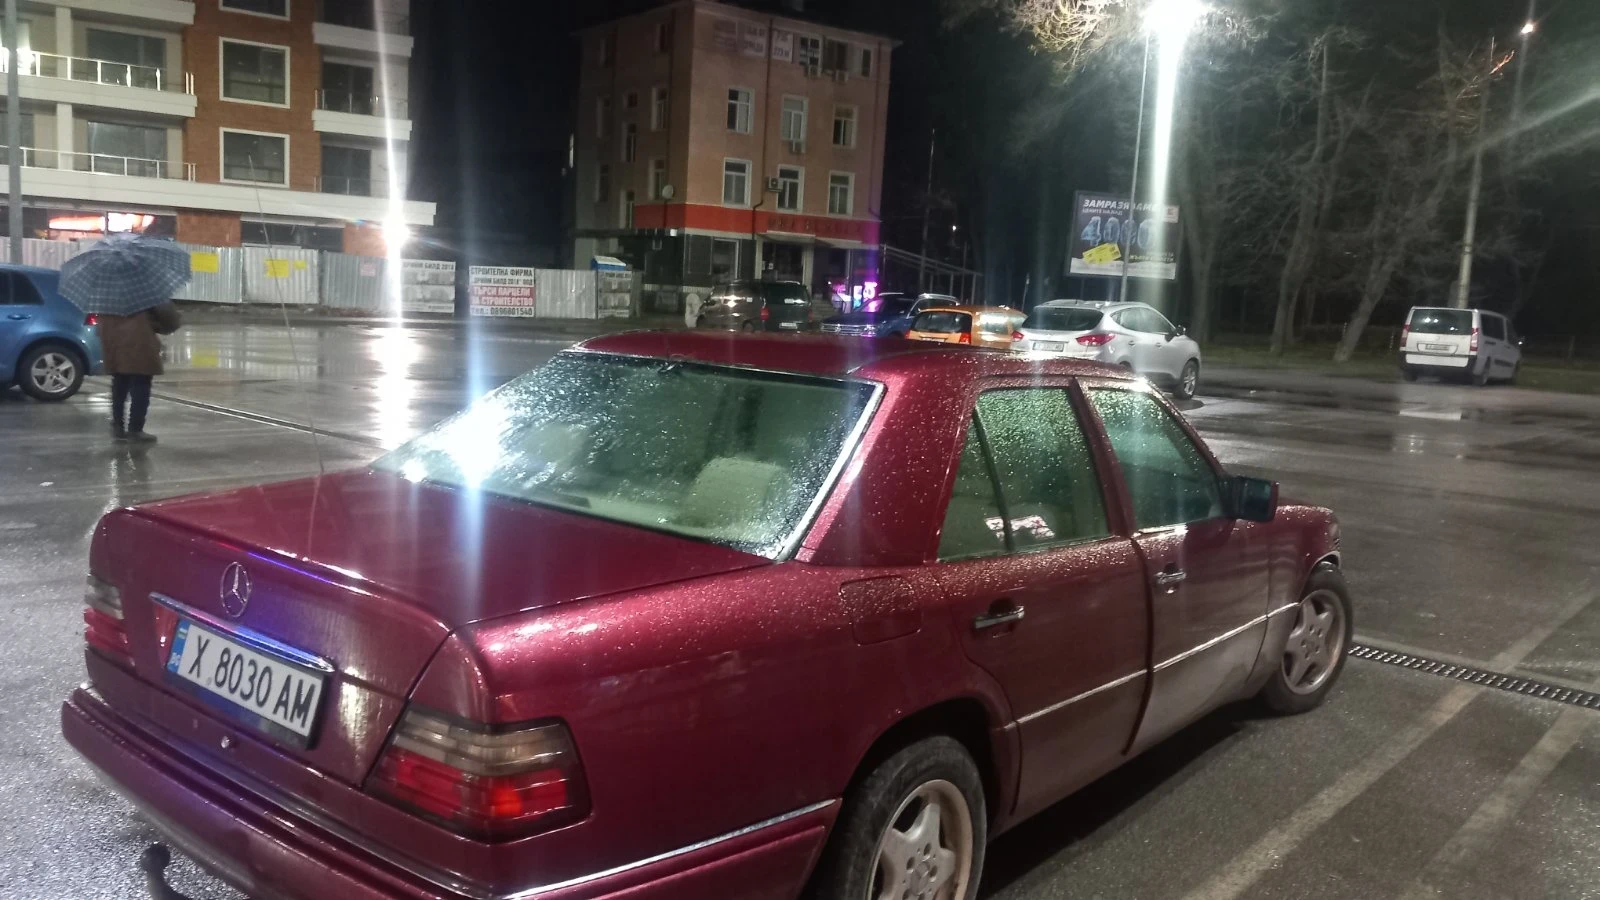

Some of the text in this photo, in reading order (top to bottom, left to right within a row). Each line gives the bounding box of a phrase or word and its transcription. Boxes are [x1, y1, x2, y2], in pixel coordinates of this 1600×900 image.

[471, 267, 533, 277] СТРОИТЕЛНА ФИРМА
[473, 286, 531, 297] ТЪРСИ ПАРЦЕЛИ
[481, 296, 534, 306] СТРОИТЕЛСТВО
[214, 647, 273, 709] 8030
[272, 674, 316, 729] AM
